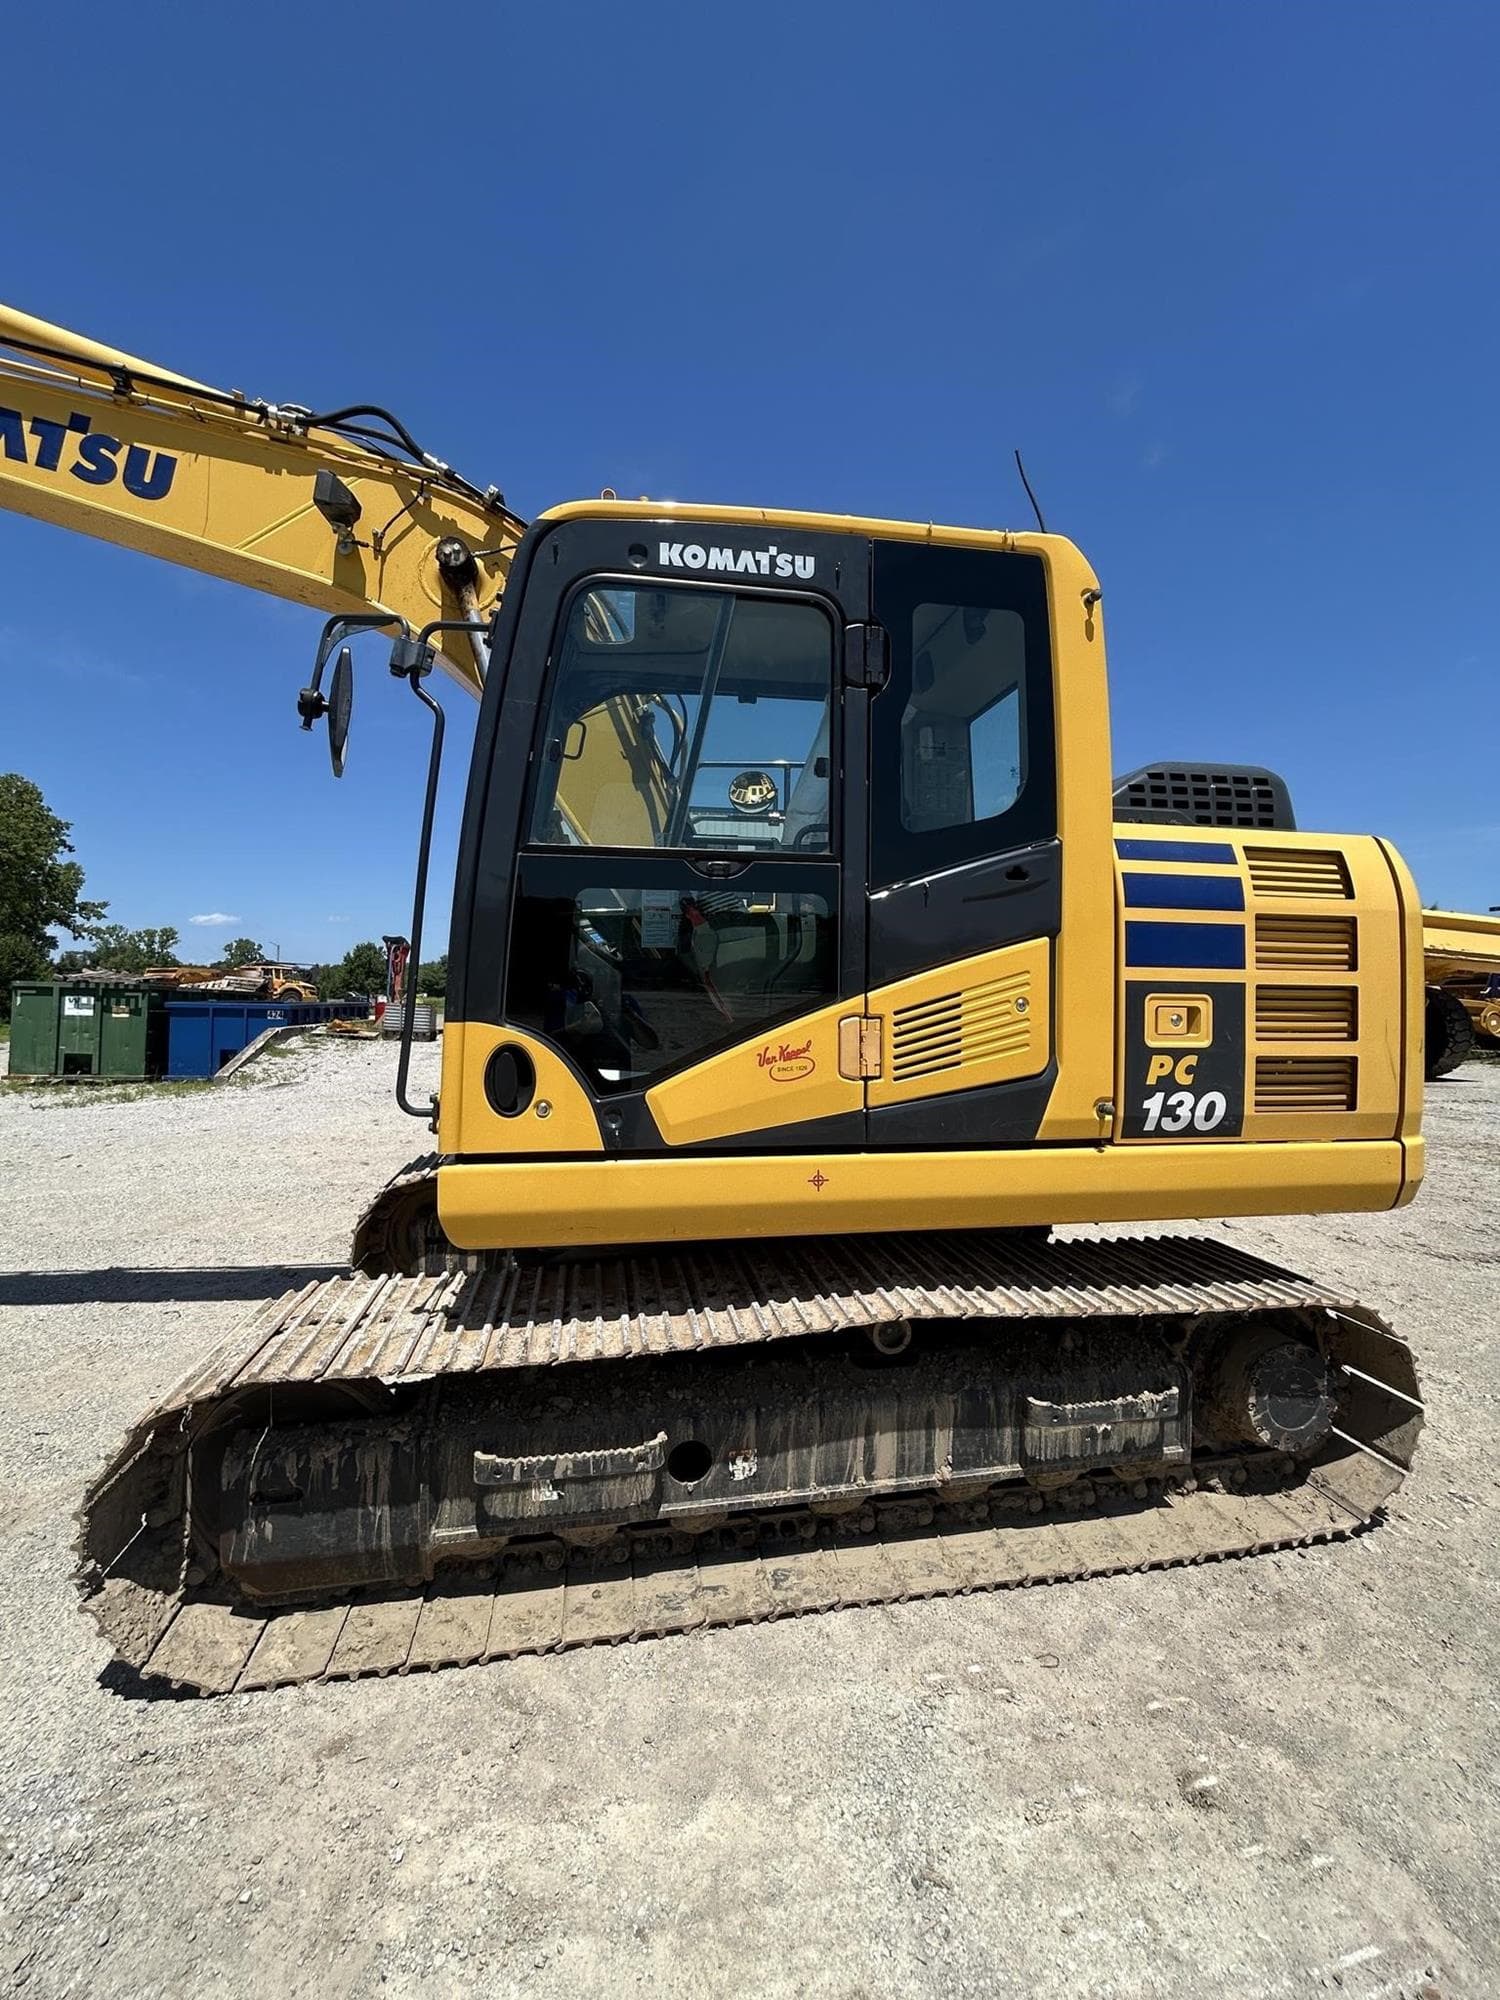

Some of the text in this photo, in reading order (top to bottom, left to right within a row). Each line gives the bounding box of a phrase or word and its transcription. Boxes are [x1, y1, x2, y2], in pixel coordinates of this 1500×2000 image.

[659, 542, 815, 579] KOMATSU
[757, 1046, 778, 1067] Van
[1146, 1055, 1198, 1085] PC
[1142, 1091, 1227, 1131] 130
